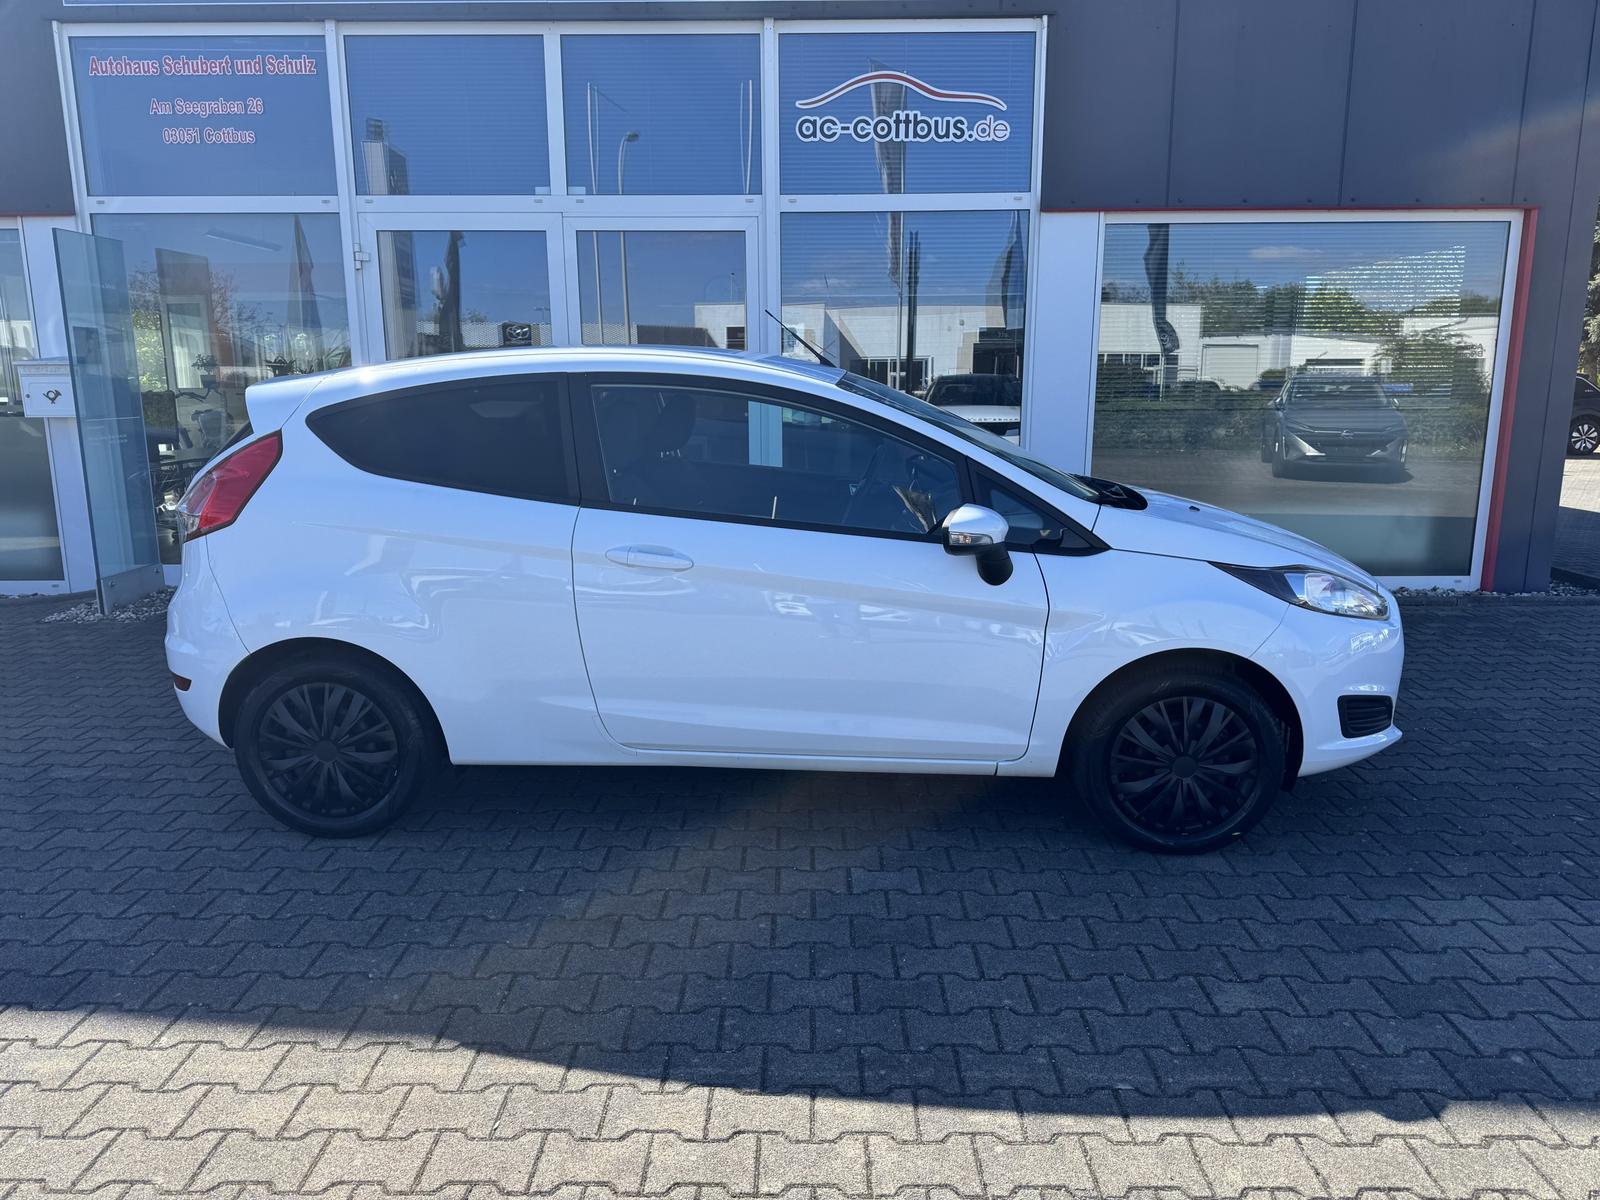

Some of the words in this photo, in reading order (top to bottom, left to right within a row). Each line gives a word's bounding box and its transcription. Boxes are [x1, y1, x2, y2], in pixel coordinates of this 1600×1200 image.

[89, 56, 160, 75] Autohaus
[163, 55, 232, 75] Schubert
[234, 55, 263, 75] und
[265, 55, 316, 75] Schulz
[150, 98, 173, 115] Am
[175, 97, 245, 118] Seegraben
[247, 98, 264, 114] 26
[163, 127, 200, 144] 03051
[204, 127, 256, 144] Cottbus
[796, 111, 1010, 142] ac-cottbus.de
